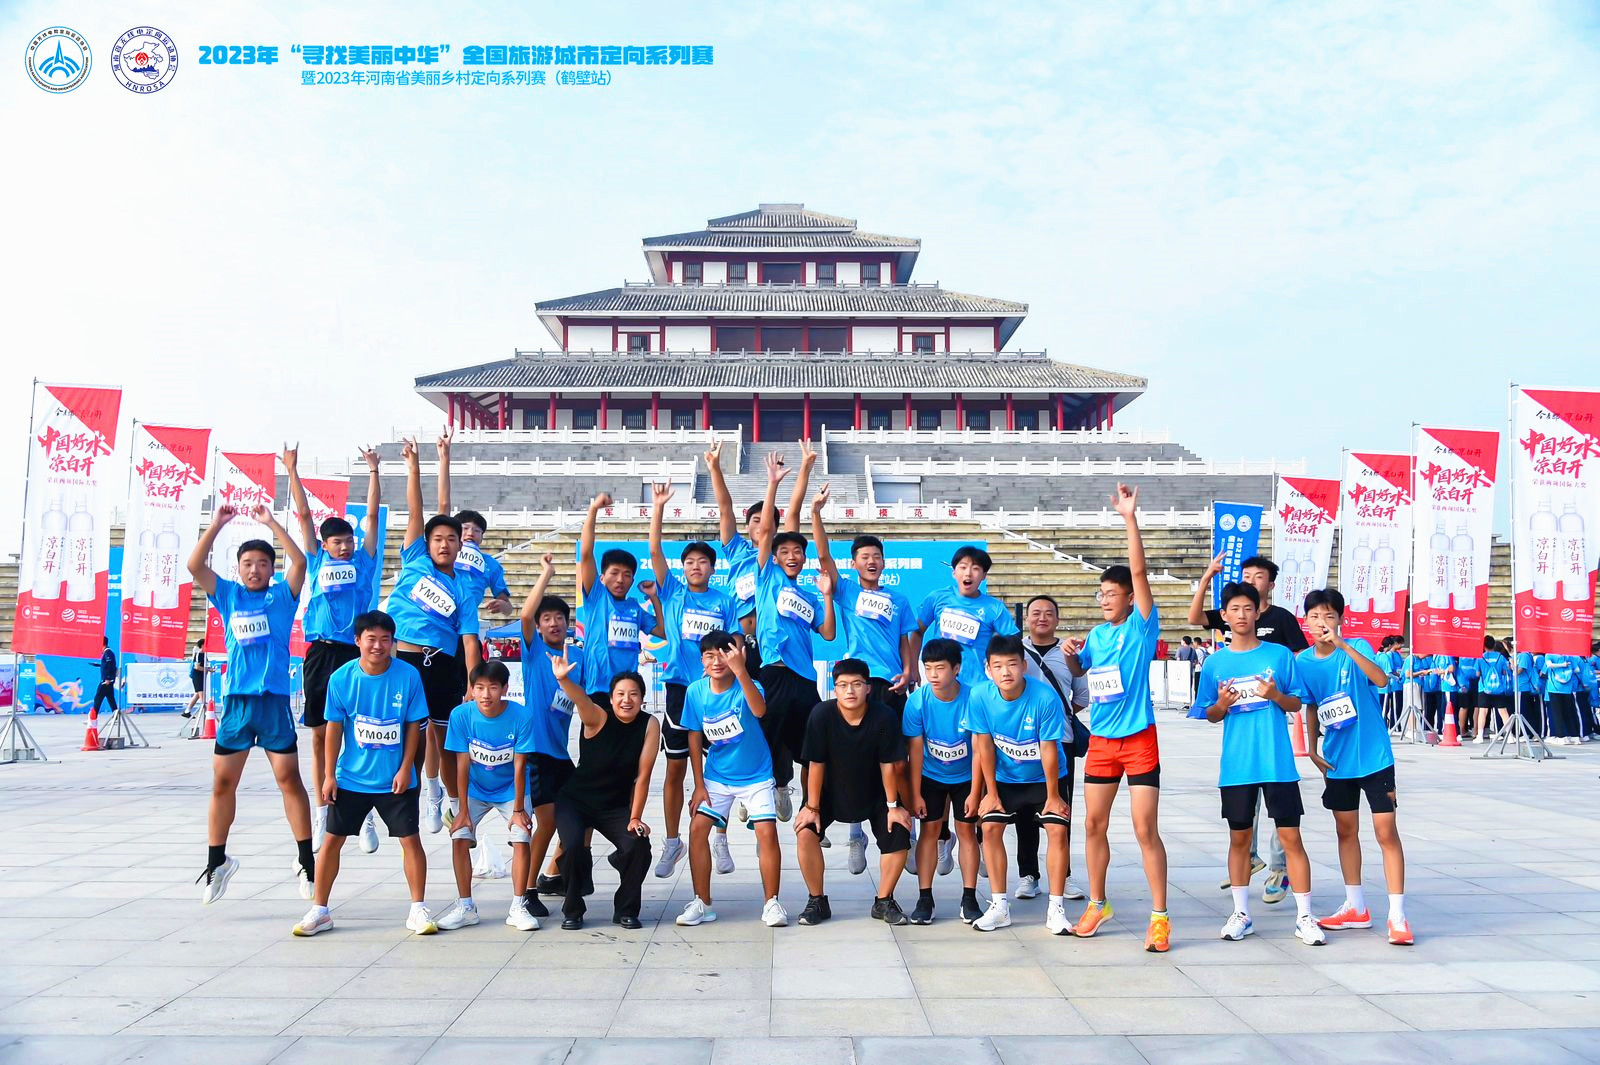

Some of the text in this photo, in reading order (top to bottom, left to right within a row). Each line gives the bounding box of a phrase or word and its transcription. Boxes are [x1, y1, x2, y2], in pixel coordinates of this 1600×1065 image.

[38, 425, 111, 458] 中国好水
[1519, 428, 1600, 462] 中国好水
[49, 454, 94, 476] 凉白开
[136, 456, 201, 486] 中国好水
[1534, 456, 1583, 479] 凉白开
[1420, 461, 1491, 490] 中国好水
[220, 481, 271, 504] 中国好水
[1348, 482, 1411, 508] 中国好水
[1432, 486, 1474, 505] 凉白开
[1279, 503, 1333, 526] 中国好水
[1357, 504, 1396, 521] 凉白开
[1286, 522, 1318, 537] 凉白开
[458, 551, 484, 567] M027
[320, 569, 354, 581] YM026
[418, 583, 452, 613] YM034
[860, 597, 893, 617] YM029
[781, 597, 813, 619] YM025
[686, 619, 723, 632] YM044
[941, 618, 975, 635] YM028
[1319, 704, 1351, 721] YM032
[357, 727, 397, 741] YM040
[705, 722, 738, 738] YM041
[471, 749, 511, 763] YM042
[929, 747, 964, 759] YM030
[997, 744, 1037, 758] YM045
